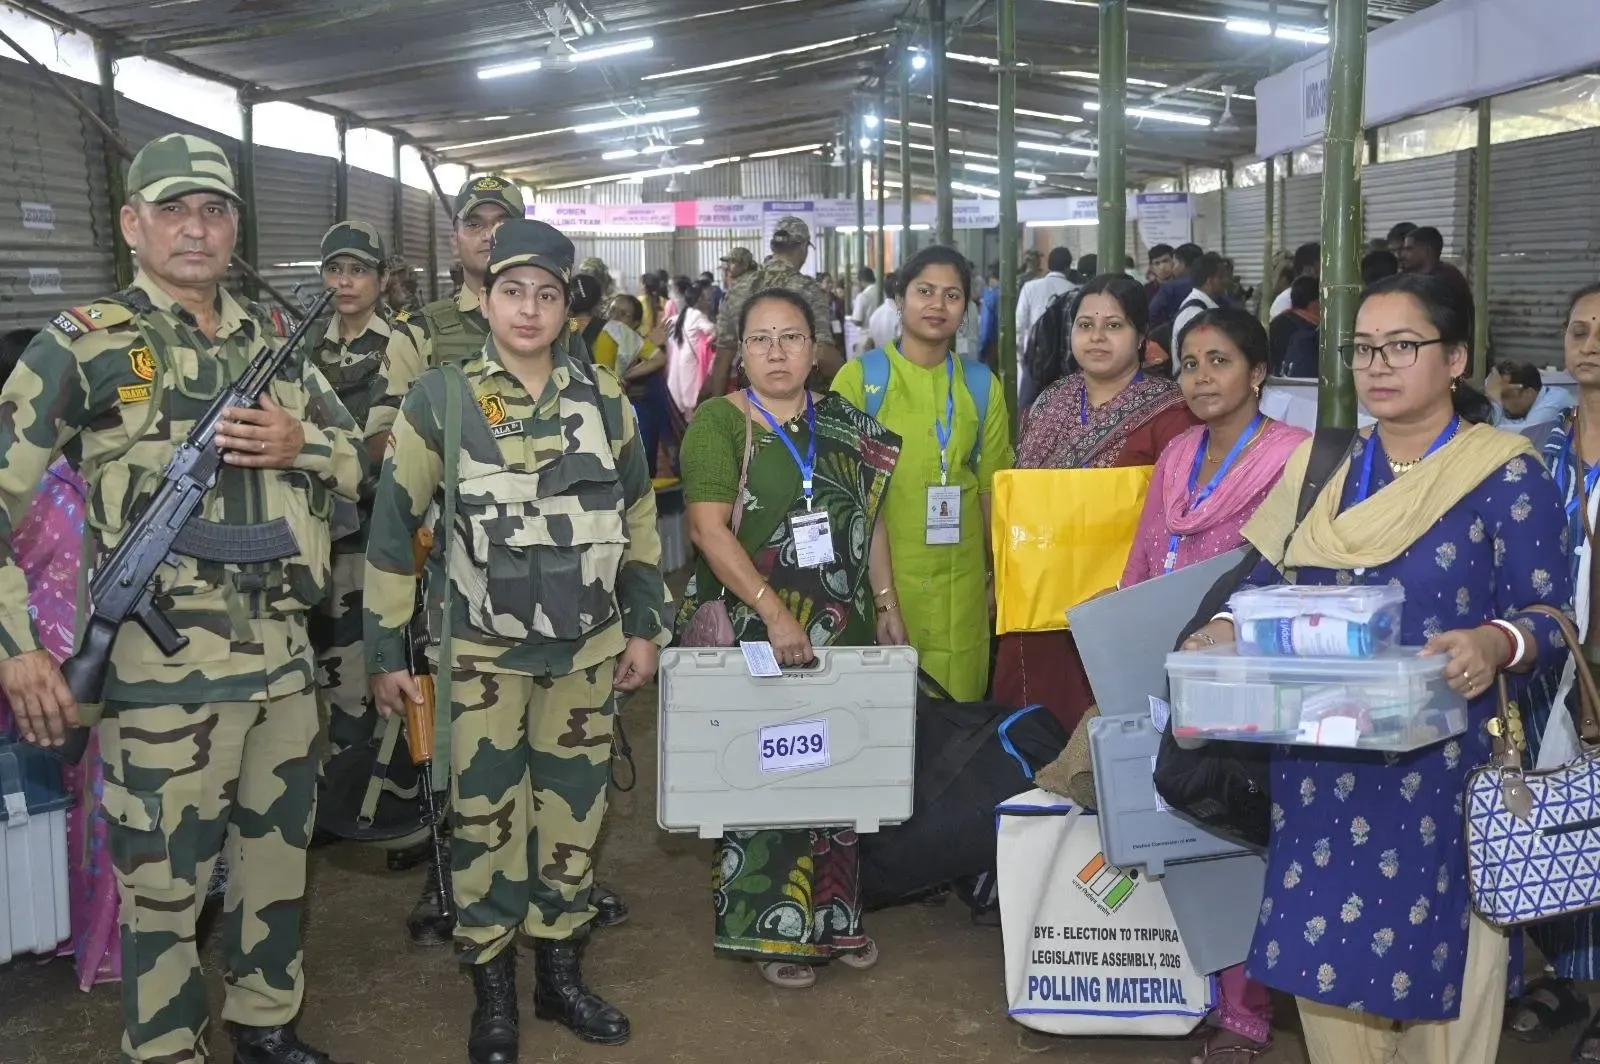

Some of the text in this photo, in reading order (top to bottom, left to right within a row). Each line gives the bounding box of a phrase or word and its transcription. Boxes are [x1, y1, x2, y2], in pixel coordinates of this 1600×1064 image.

[54, 314, 78, 333] BSF
[491, 425, 511, 435] ALA
[762, 733, 823, 759] 56/39
[1034, 926, 1054, 940] BYE
[1063, 927, 1117, 941] ELECTION
[1120, 928, 1132, 941] TO
[1134, 928, 1179, 943] TRIPURA
[1032, 949, 1181, 970] LEGISLATIVE ASSEMBLY, 2026
[1028, 975, 1188, 1005] POLLING MATERIAL
